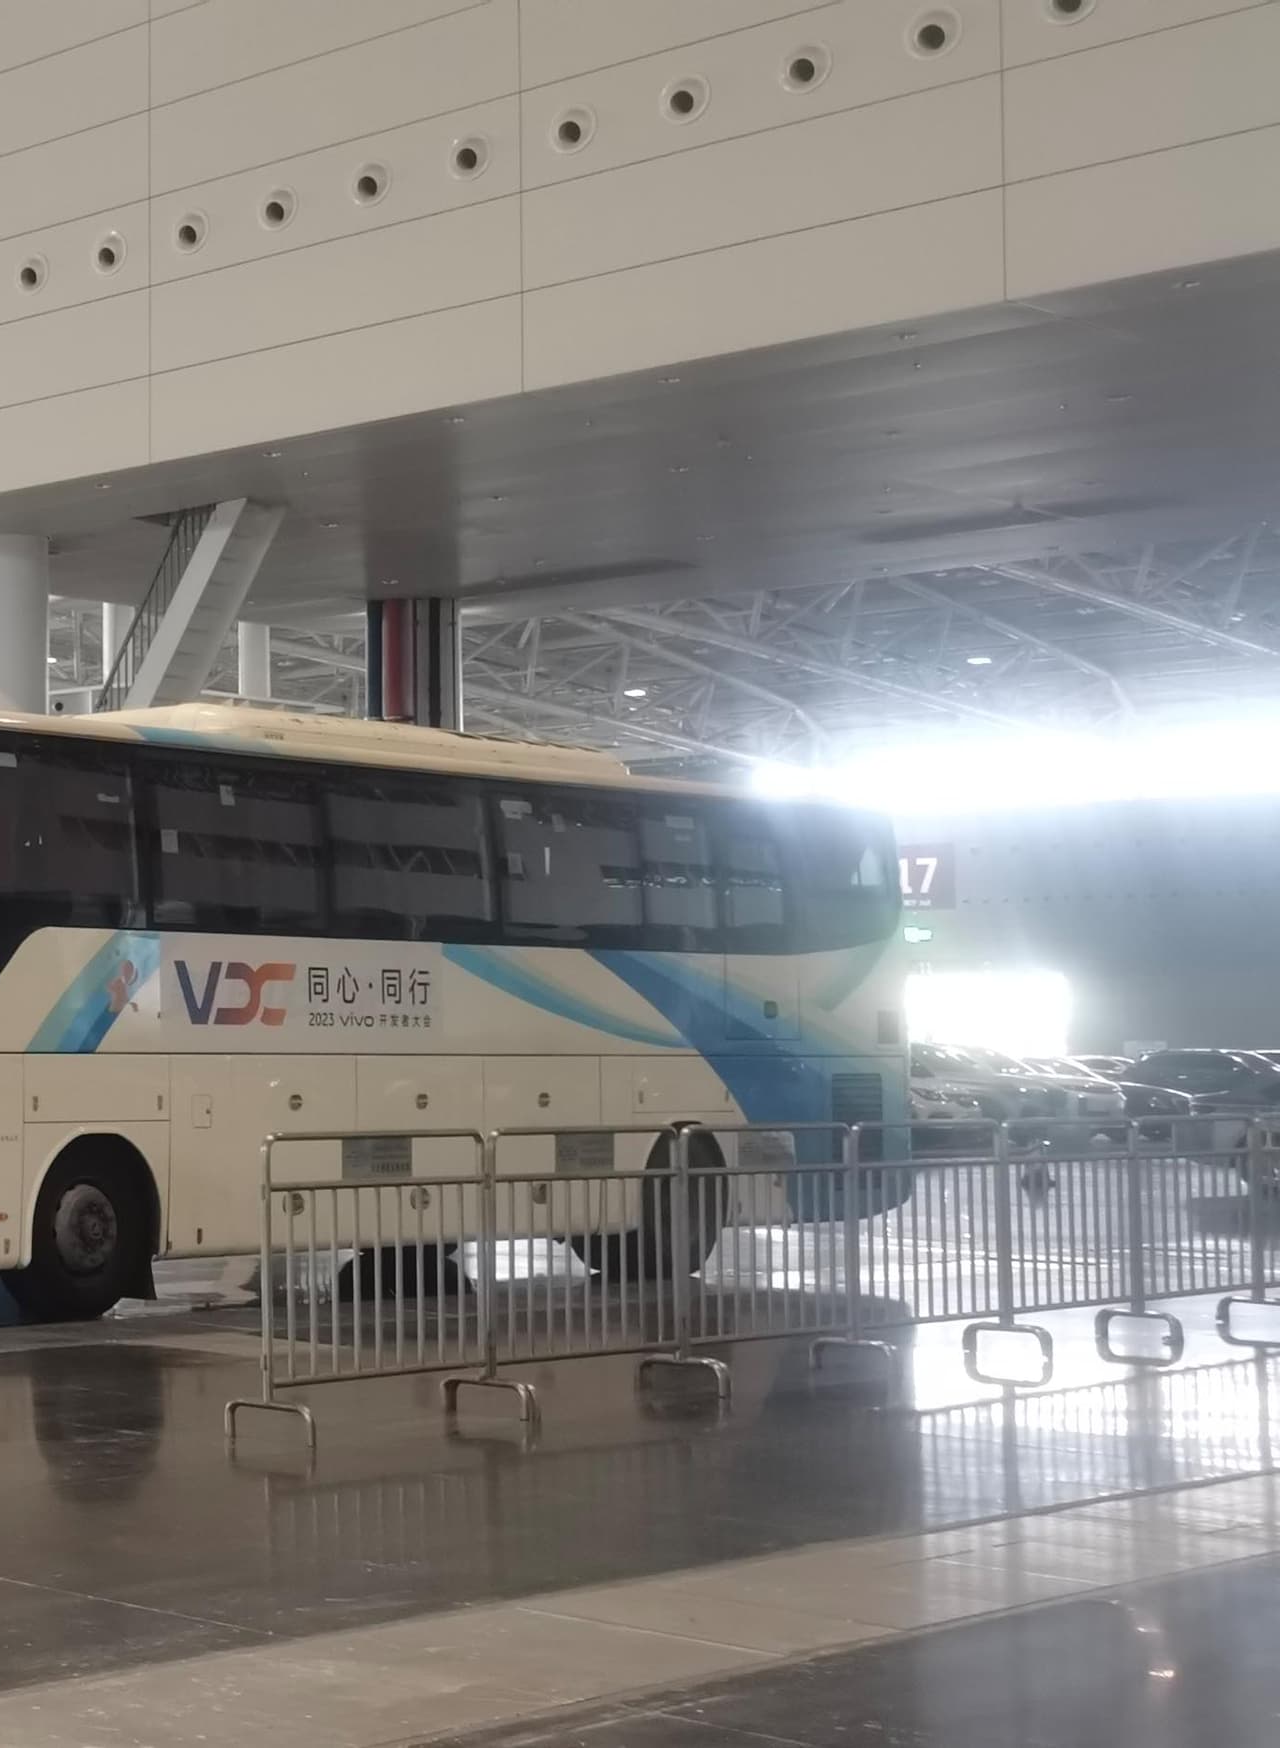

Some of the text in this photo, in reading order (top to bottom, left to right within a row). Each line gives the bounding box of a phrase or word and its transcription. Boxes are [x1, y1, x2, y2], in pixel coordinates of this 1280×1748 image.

[173, 959, 297, 1026] VDC
[307, 966, 432, 1006] 同心·同行
[308, 1011, 432, 1028] 2023 vivo 开发者大会
